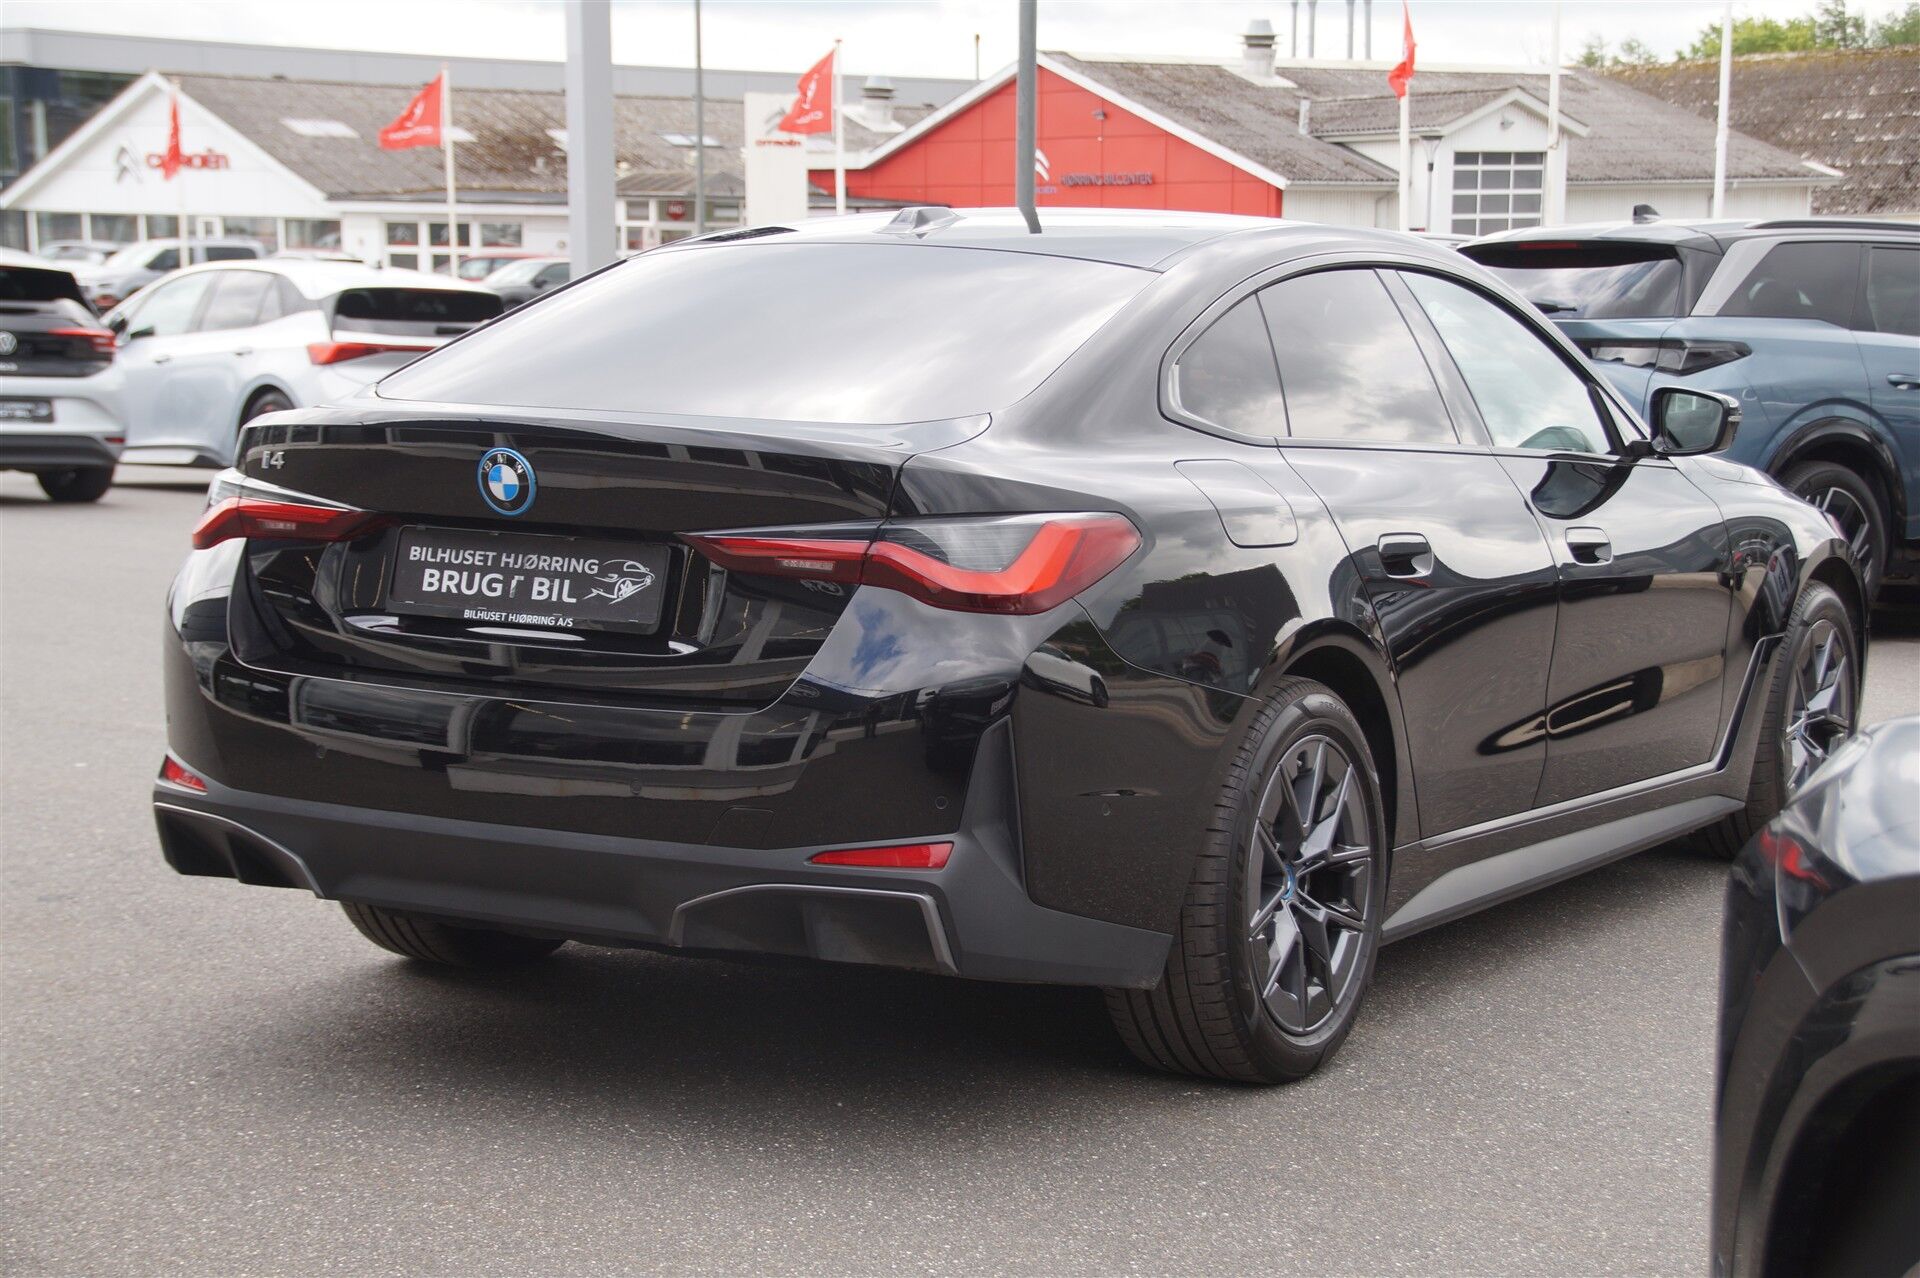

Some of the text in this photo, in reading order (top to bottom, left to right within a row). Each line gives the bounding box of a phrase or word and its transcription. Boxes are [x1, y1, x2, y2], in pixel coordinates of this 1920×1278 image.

[484, 453, 525, 474] BMW
[408, 545, 600, 575] BILHUSET HJØRRING
[530, 576, 577, 603] BIL
[463, 608, 574, 628] BILHUSET HJØRRING A/S
